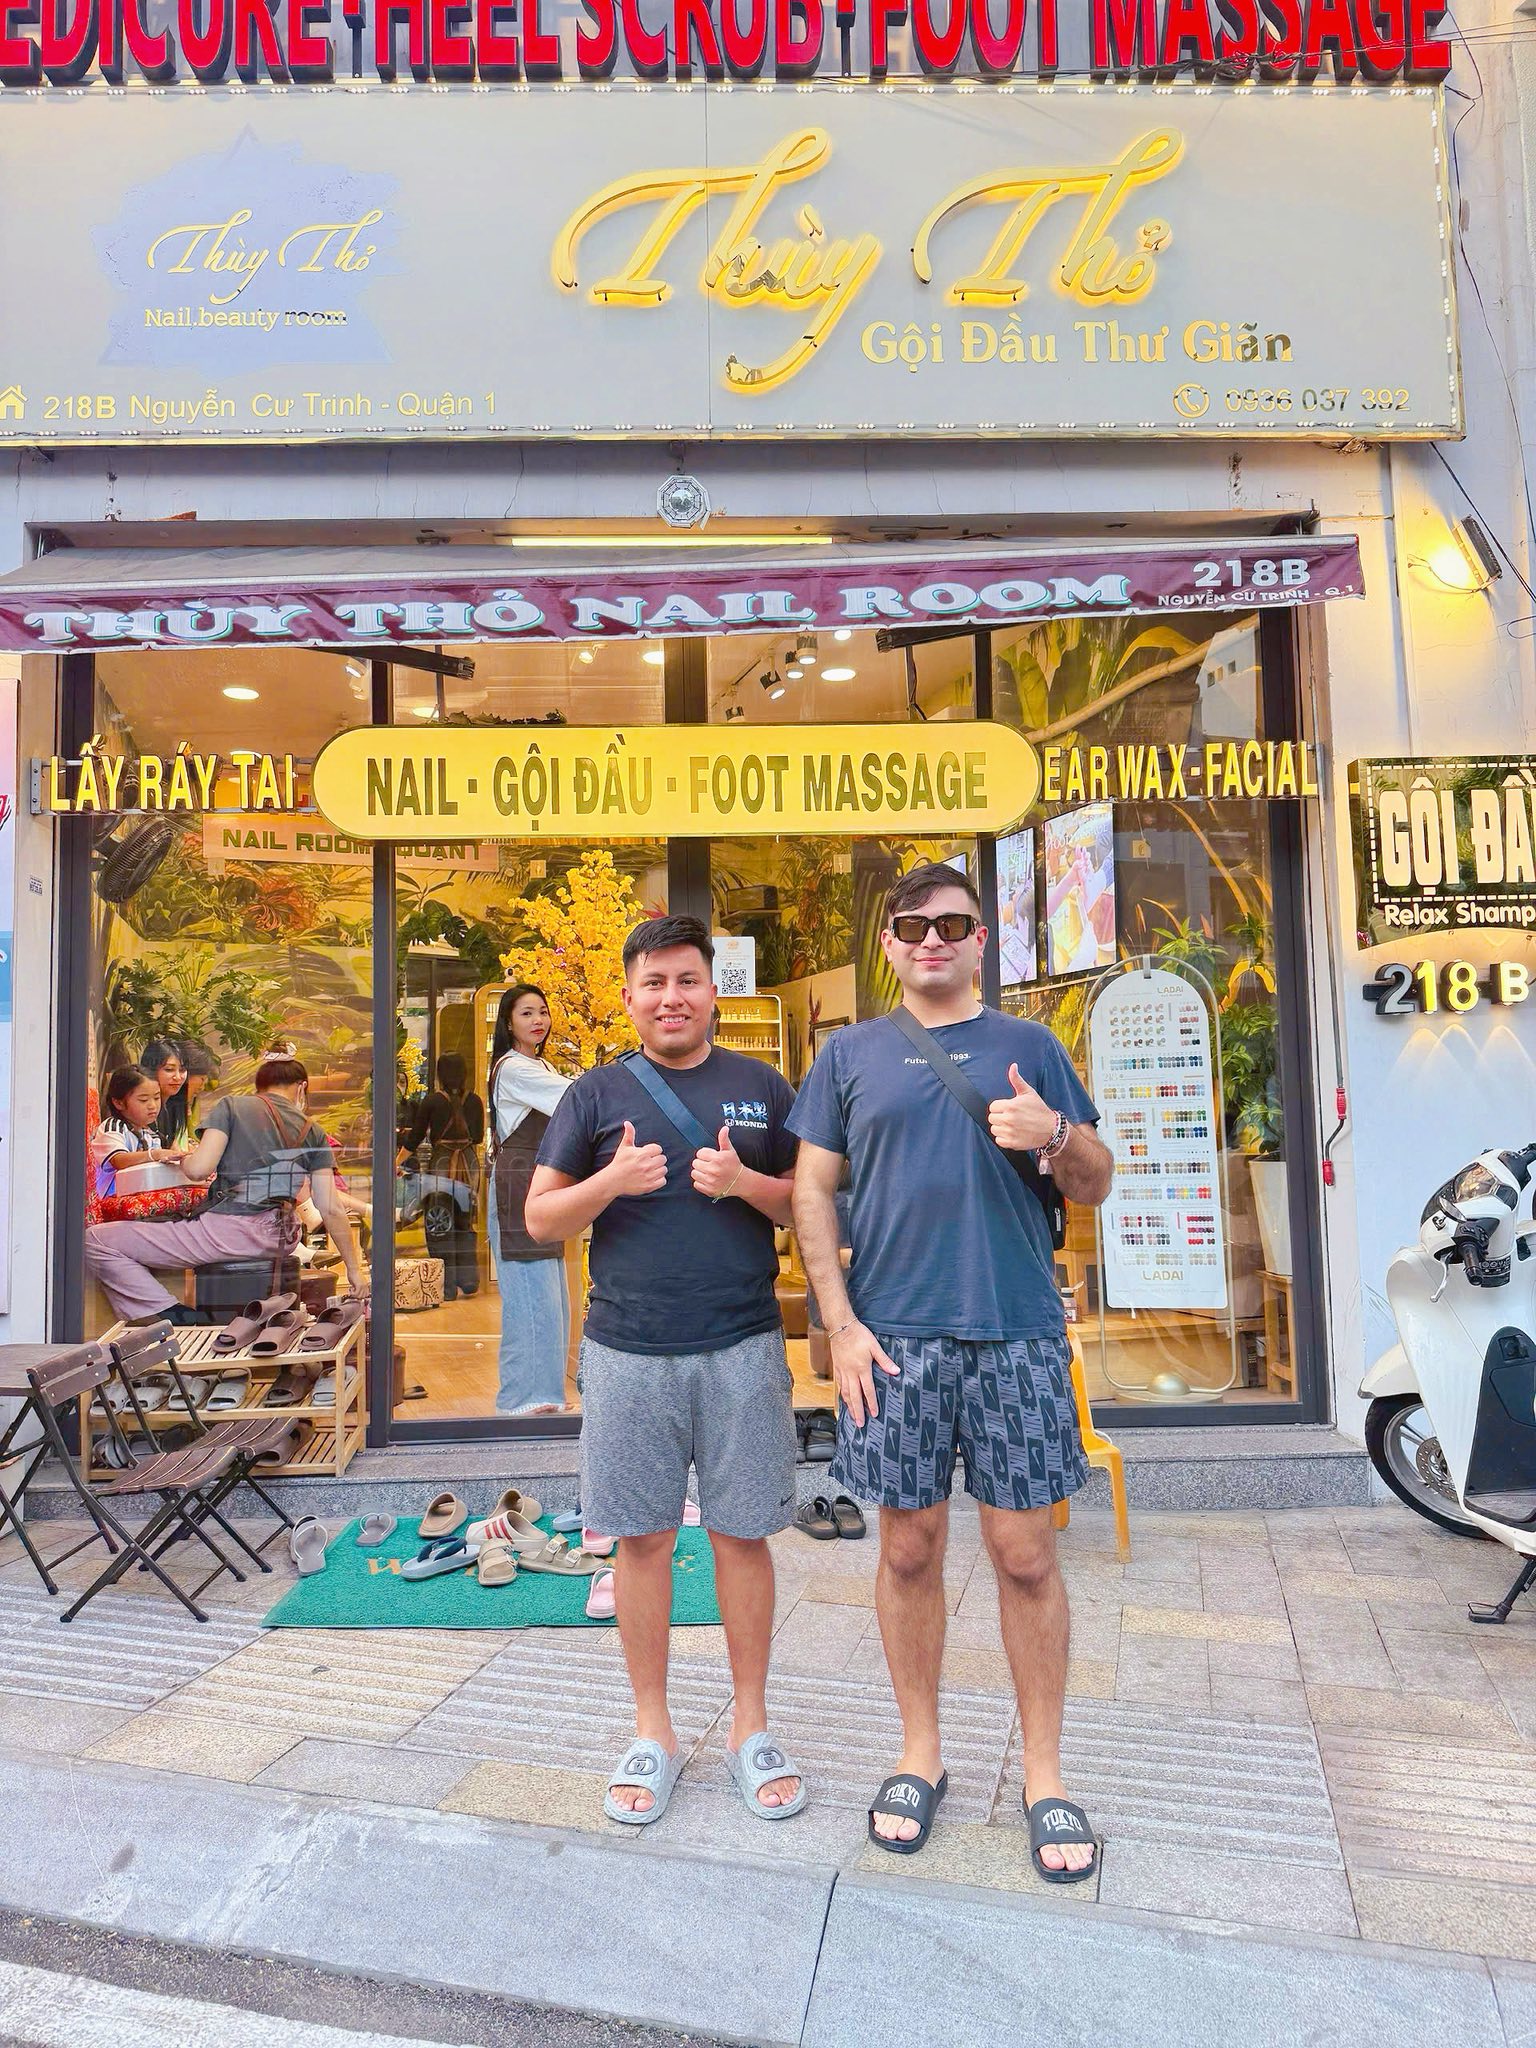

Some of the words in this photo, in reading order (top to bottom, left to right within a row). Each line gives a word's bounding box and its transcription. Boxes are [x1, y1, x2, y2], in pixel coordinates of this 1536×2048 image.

[147, 208, 270, 305] Thùy
[552, 127, 880, 386] Thùy
[913, 128, 1183, 299] Thỏ
[284, 309, 348, 327] room
[861, 320, 945, 374] Gội
[960, 312, 1059, 364] Đầu
[1073, 320, 1169, 363] Thư
[1183, 320, 1294, 363] Giãn
[43, 395, 117, 420] 218B
[129, 388, 236, 424] Nguyễn
[251, 393, 294, 417] Cư
[304, 392, 372, 416] Trinh
[397, 391, 473, 420] Quận
[484, 392, 496, 414] 1
[1225, 388, 1294, 412] 0936
[1301, 388, 1350, 412] 037
[1360, 388, 1412, 412] 392
[1193, 558, 1311, 588] 218B
[569, 592, 818, 629] NAIL
[839, 574, 1134, 619] ROOM
[1158, 589, 1226, 606] NGUYỄN
[1259, 589, 1310, 602] TRINH
[50, 733, 125, 812] LẤY
[139, 741, 219, 811] RÁY
[232, 753, 294, 810] TAI
[367, 757, 459, 816] NAIL
[493, 742, 561, 832] GỘI
[573, 733, 653, 816] ĐẦU
[689, 754, 789, 814] FOOT
[803, 750, 988, 813] MASSAGE
[1044, 745, 1110, 801] EAR
[223, 828, 288, 850] NAIL
[296, 833, 371, 855] ROOM
[1378, 776, 1461, 896] GỘI
[1470, 768, 1536, 884] ĐẦ
[1384, 903, 1450, 927] Relax
[735, 1119, 768, 1130] HONDA
[884, 1783, 921, 1808] TOKYO
[1042, 1808, 1083, 1832] TOKYO
